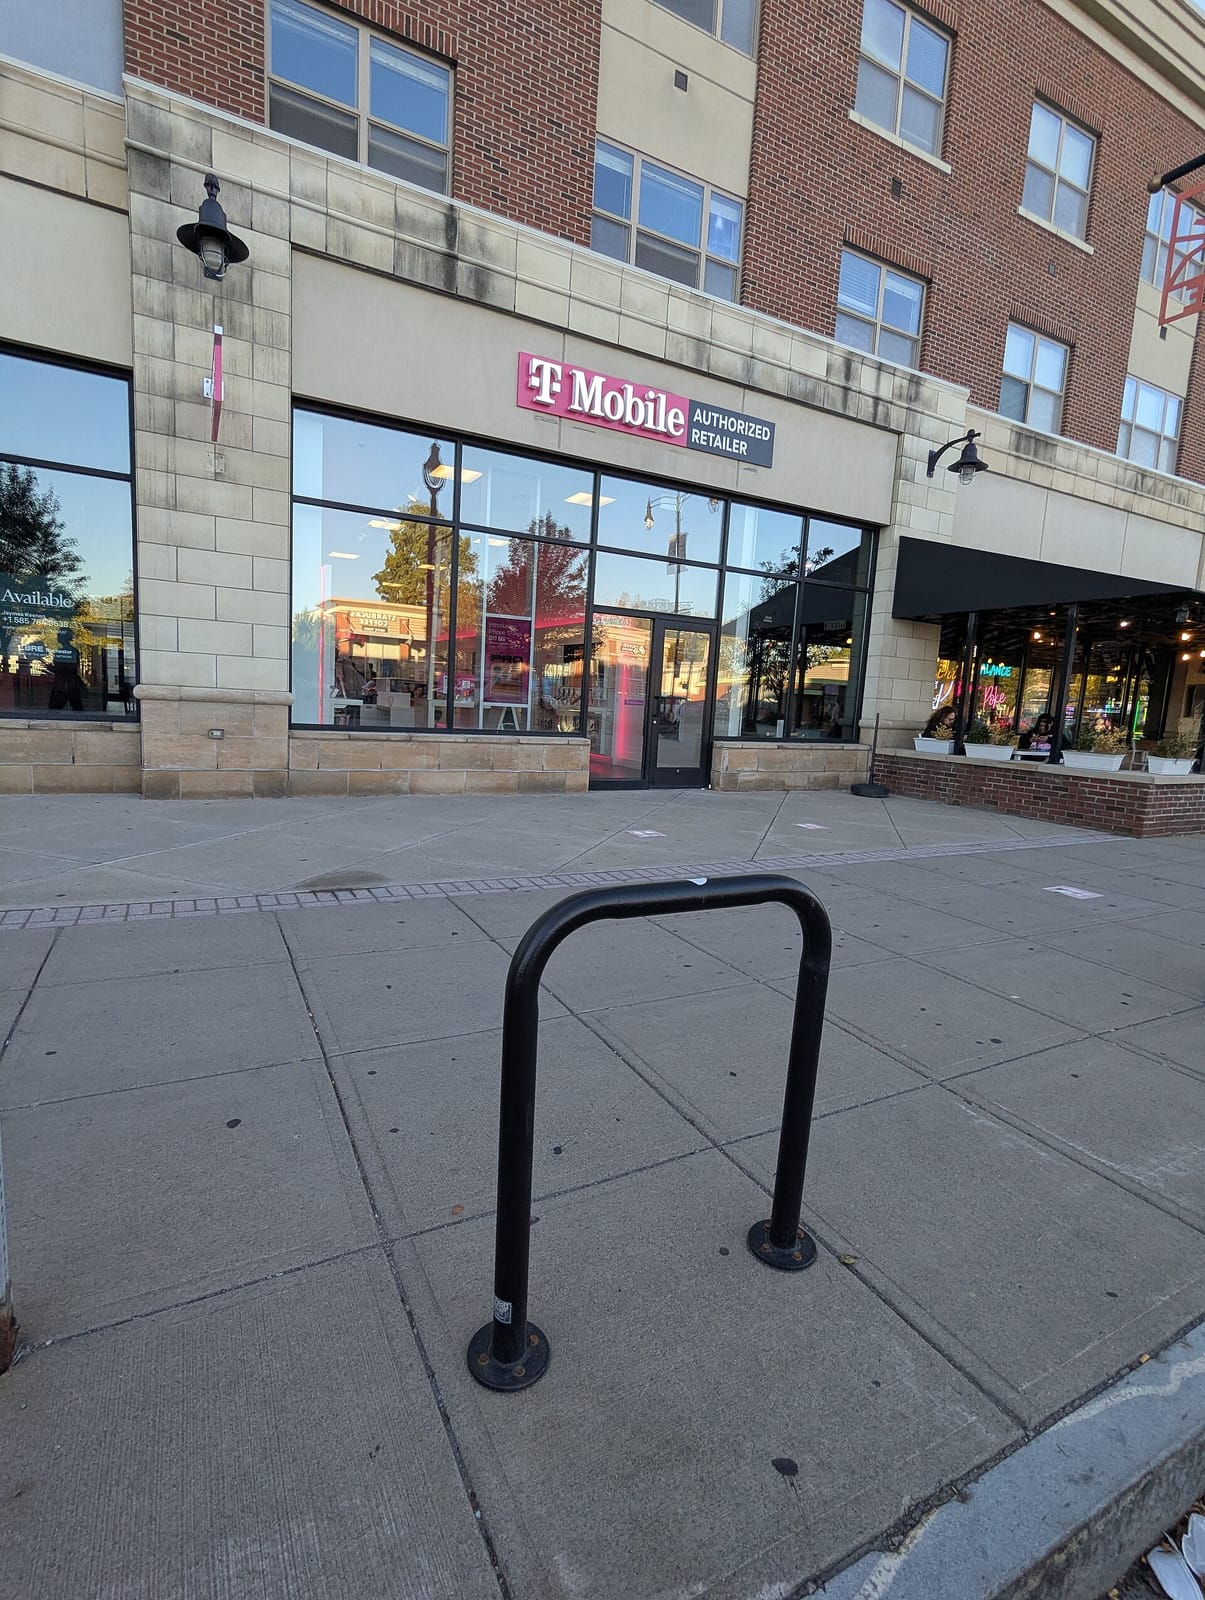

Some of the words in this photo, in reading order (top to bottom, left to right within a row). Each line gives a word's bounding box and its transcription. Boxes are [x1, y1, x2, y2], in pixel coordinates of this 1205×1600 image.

[568, 368, 685, 437] Mobile
[693, 408, 771, 441] AUTHORIZED
[691, 428, 748, 456] RETAILER
[1, 588, 74, 608] Available
[982, 685, 1007, 710] Poke
